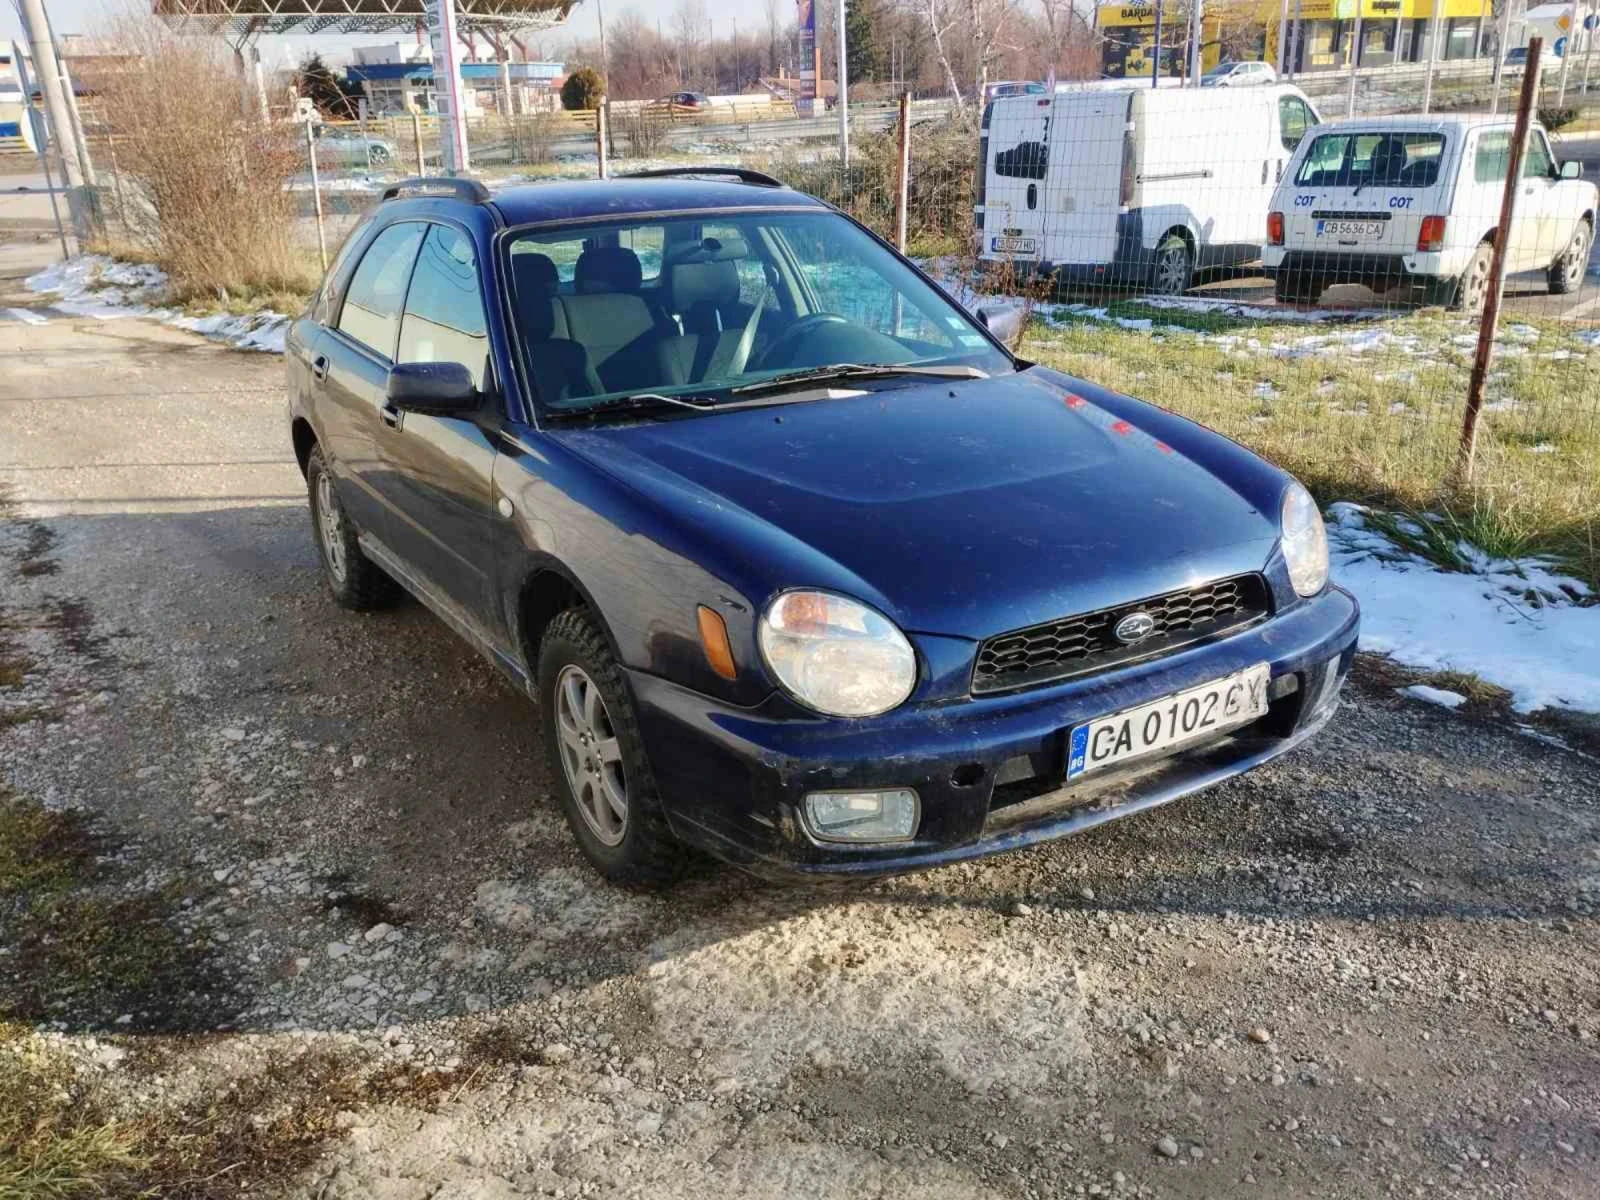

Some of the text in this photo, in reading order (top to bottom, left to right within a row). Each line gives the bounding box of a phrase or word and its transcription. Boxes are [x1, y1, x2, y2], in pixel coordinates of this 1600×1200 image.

[1294, 195, 1316, 207] COT
[1389, 196, 1414, 208] COT
[1091, 719, 1133, 762] CA
[1143, 691, 1219, 746] 0102
[1070, 755, 1084, 771] BG
